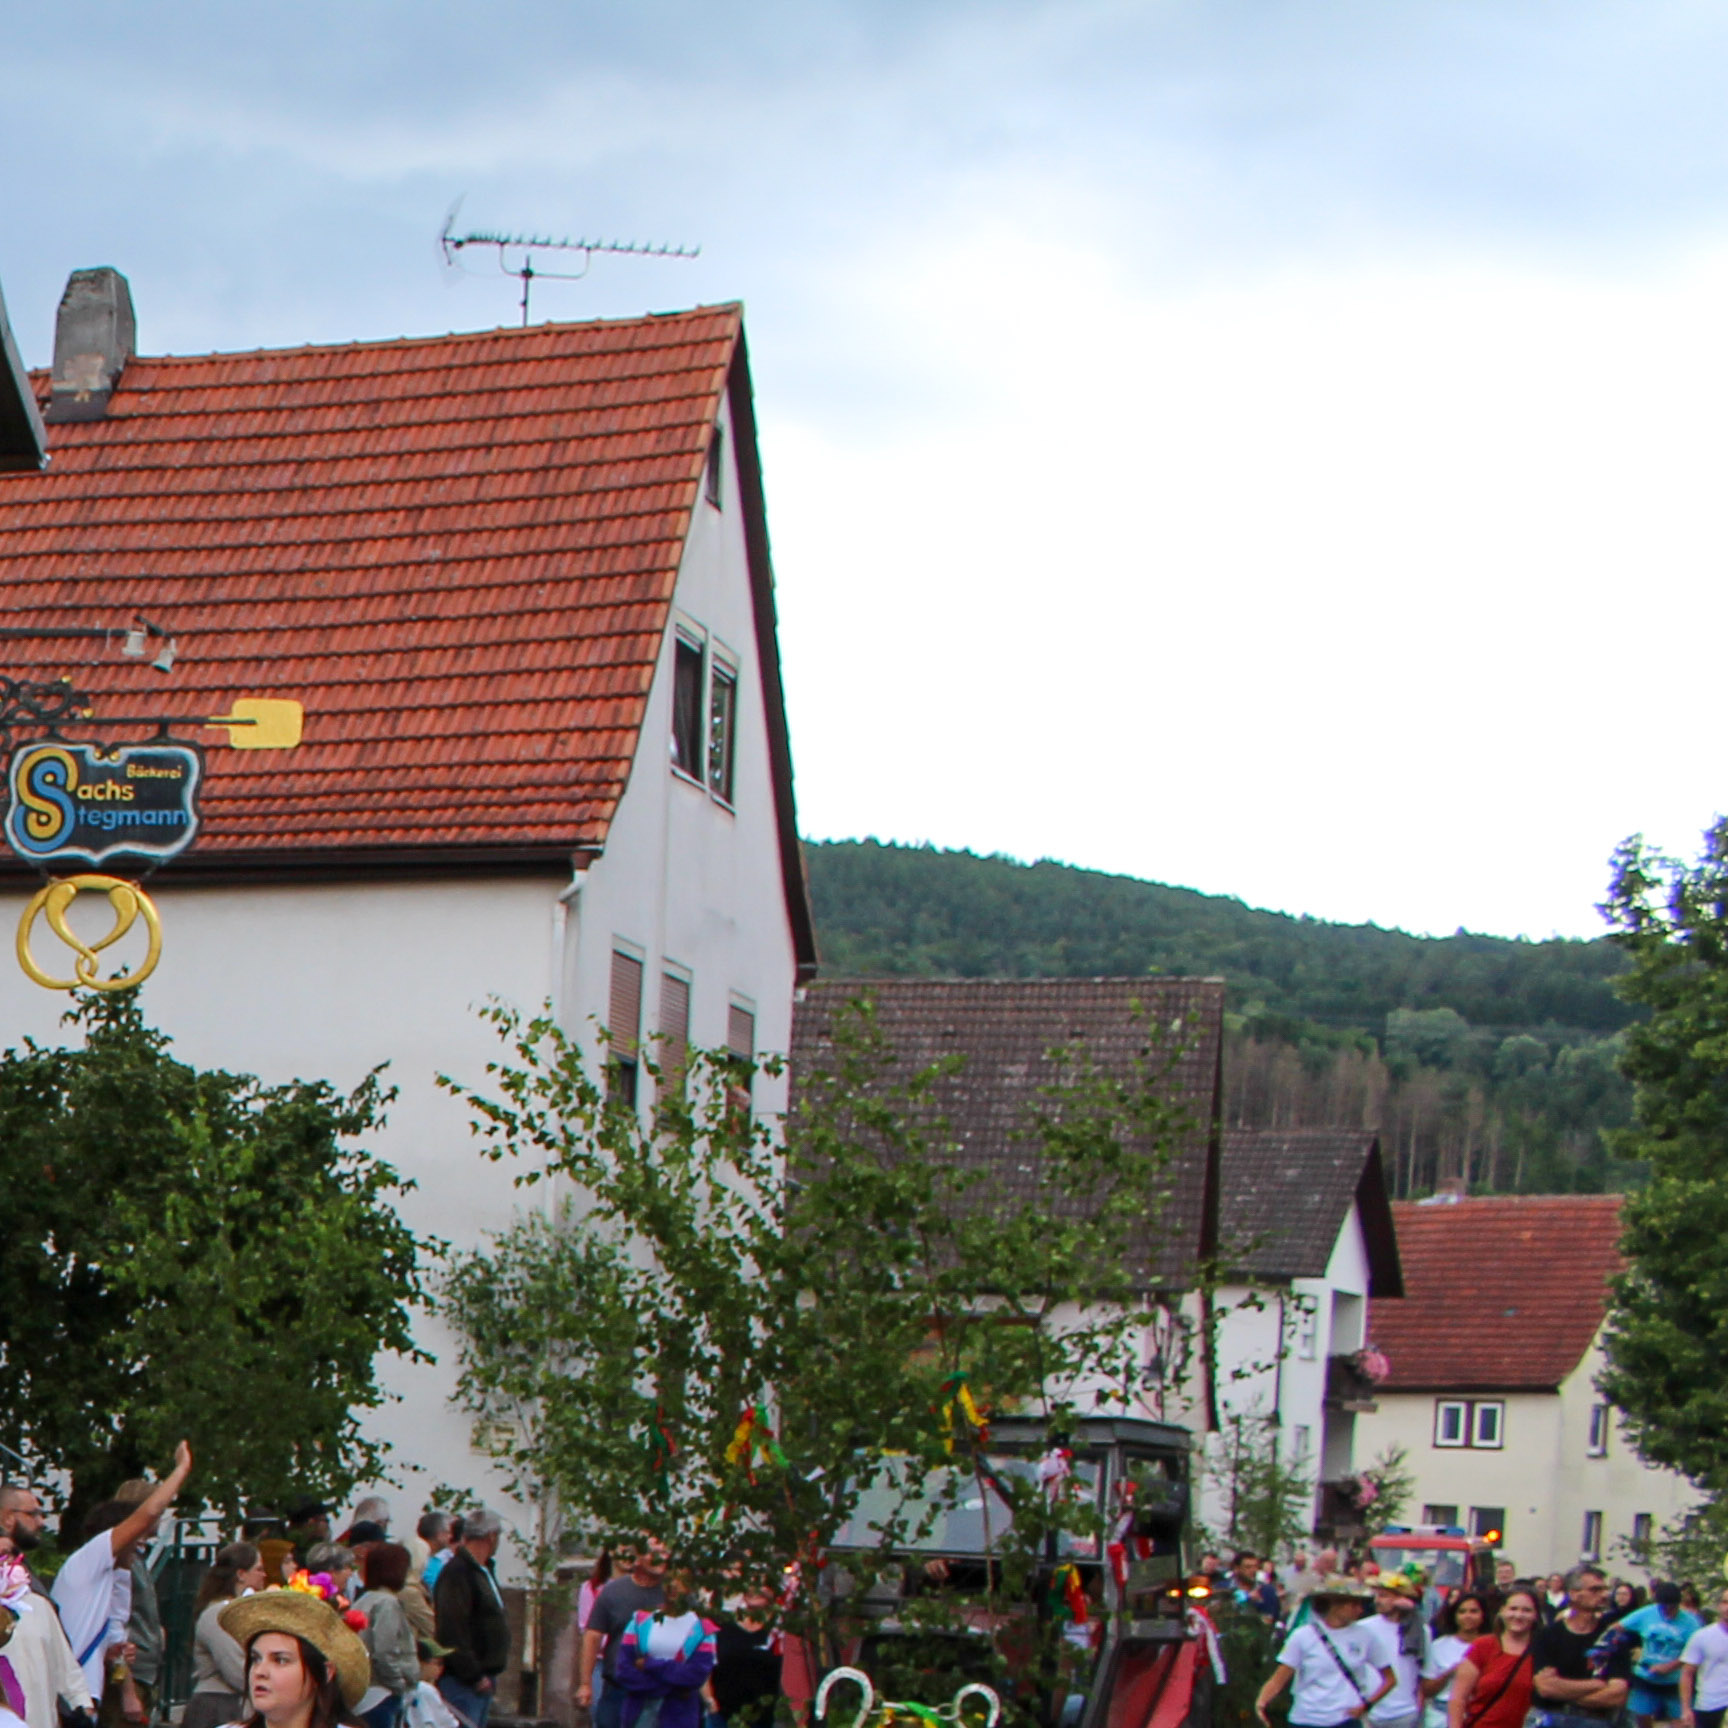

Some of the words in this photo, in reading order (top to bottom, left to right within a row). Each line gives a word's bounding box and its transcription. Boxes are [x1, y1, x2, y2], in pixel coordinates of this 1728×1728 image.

[14, 759, 187, 852] Stegmann
[17, 747, 134, 839] Sachs
[126, 764, 182, 779] Bäckerei
